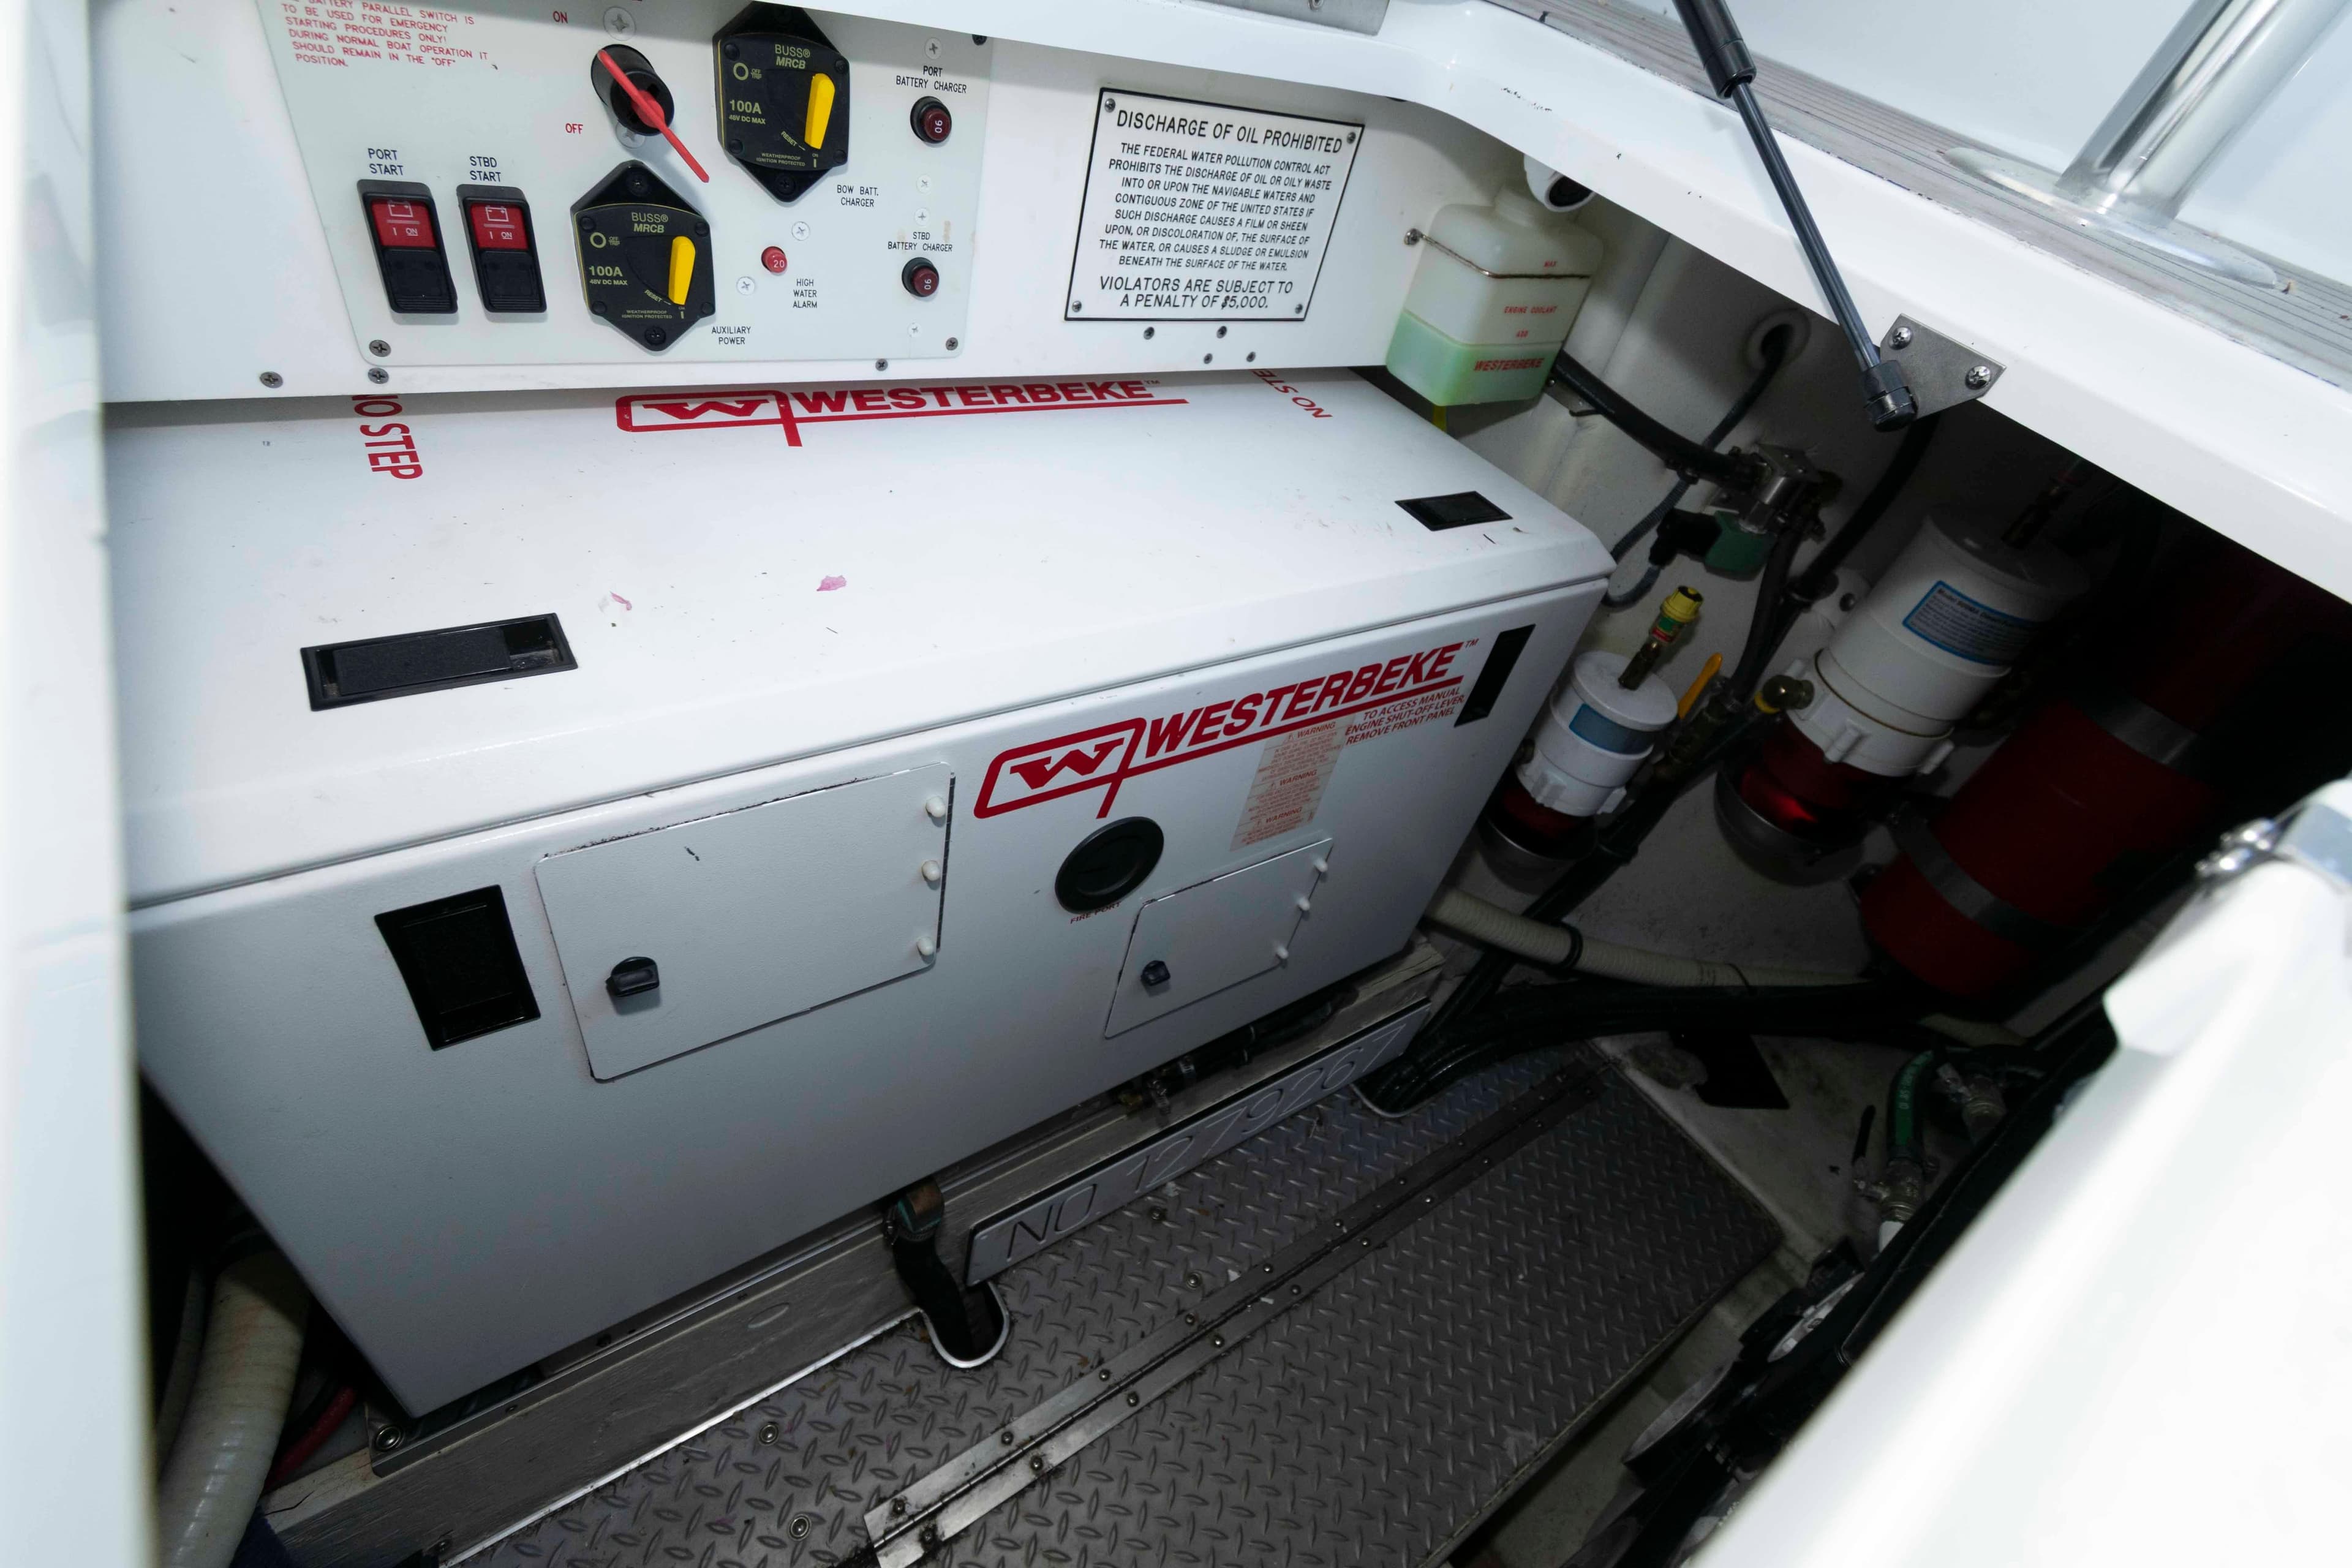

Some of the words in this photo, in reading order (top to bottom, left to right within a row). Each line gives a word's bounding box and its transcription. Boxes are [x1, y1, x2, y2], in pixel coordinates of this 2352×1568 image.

[282, 3, 297, 13] TO
[304, 7, 318, 17] BE
[326, 9, 354, 21] USED
[362, 13, 382, 24] FOR
[390, 18, 448, 32] EMERGENCY
[363, 2, 412, 17] PARALLEL
[420, 10, 458, 23] SWITCH
[465, 16, 475, 24] IS
[552, 10, 568, 23] ON
[285, 17, 336, 31] STARTING
[344, 23, 412, 40] PROCEDURES
[418, 33, 447, 43] ONLY!
[288, 29, 329, 41] DURING
[336, 34, 379, 47] NORMAL
[386, 40, 411, 51] BOAT
[419, 45, 472, 58] OPERATION
[292, 42, 334, 54] SHOULD
[342, 47, 382, 59] REMAIN
[388, 52, 399, 61] IN
[406, 54, 425, 64] THE
[295, 53, 349, 67] POSITION.
[776, 56, 806, 69] MRCB
[923, 65, 943, 77] PORT
[896, 75, 929, 89] BATTERY
[934, 81, 967, 93] CHARGER
[729, 99, 762, 114] 100A
[565, 123, 583, 134] OFF
[1117, 110, 1208, 137] DISCHARGE
[1213, 123, 1234, 140] OF
[1237, 126, 1258, 143] OIL
[1263, 129, 1343, 153] PROHIBITED
[780, 130, 797, 147] RESET
[368, 148, 398, 160] PORT
[470, 156, 497, 167] STBD
[1121, 142, 1141, 155] THE
[1144, 145, 1188, 160] FEDERAL
[1191, 151, 1223, 164] WATER
[1225, 154, 1272, 169] POLLUTION
[1274, 160, 1311, 173] CONTROL
[1314, 165, 1330, 175] ACT
[369, 164, 404, 175] START
[470, 170, 501, 182] START
[1109, 159, 1161, 174] PROHIBITS
[1164, 165, 1183, 176] THE
[1186, 167, 1237, 181] DISCHARGE
[1240, 173, 1252, 183] OF
[1254, 174, 1267, 184] OIL
[1270, 176, 1282, 186] OR
[1284, 177, 1303, 187] OILY
[1305, 179, 1332, 190] WASTE
[837, 184, 854, 194] BOW
[860, 186, 879, 196] BATT.
[1122, 177, 1144, 188] INTO
[1147, 179, 1161, 190] OR
[1164, 181, 1189, 192] UPON
[1192, 184, 1210, 194] THE
[1212, 185, 1261, 198] NAVIGABLE
[1263, 190, 1297, 202] WATERS
[1298, 194, 1316, 203] AND
[841, 197, 875, 208] CHARGER
[1115, 193, 1177, 207] CONTIGUOUS
[1179, 198, 1204, 209] ZONE
[1207, 201, 1219, 210] OF
[1221, 202, 1240, 212] THE
[1240, 205, 1271, 214] UNITED
[1273, 206, 1304, 216] STATES
[1306, 208, 1314, 217] IF
[633, 223, 665, 233] MRCB
[1115, 209, 1142, 221] SUCH
[1144, 211, 1197, 224] DISCHARGE
[1200, 215, 1235, 226] CAUSES
[1237, 218, 1243, 227] A
[1245, 218, 1265, 228] FILM
[1267, 220, 1279, 229] OR
[1280, 221, 1308, 231] SHEEN
[405, 227, 418, 236] ON
[913, 232, 930, 240] STBD
[1105, 224, 1133, 236] UPON,
[1136, 226, 1150, 236] OR
[1152, 227, 1223, 240] DISCOLORATION
[1242, 233, 1257, 243] THE
[1259, 234, 1296, 244] SURFACE
[1298, 236, 1310, 245] OF
[888, 241, 918, 251] BATTERY
[922, 243, 952, 252] CHARGER
[1099, 239, 1118, 250] THE
[1122, 240, 1155, 252] WATER,
[1158, 243, 1171, 252] OR
[1174, 244, 1209, 254] CAUSES
[1211, 246, 1217, 254] A
[1220, 246, 1253, 256] SLUDGE
[1255, 247, 1267, 257] OR
[1268, 248, 1309, 258] EMULSION
[589, 265, 623, 277] 100A
[774, 260, 785, 268] 20
[1118, 255, 1163, 266] BENEATH
[1166, 257, 1183, 268] THE
[1185, 258, 1225, 269] SURFACE
[1227, 260, 1239, 270] OF
[1242, 261, 1257, 270] THE
[1259, 262, 1287, 271] WATER.
[1100, 276, 1180, 292] VIOLATORS
[1184, 279, 1212, 292] ARE
[1215, 279, 1275, 293] SUBJECT
[1278, 281, 1294, 293] TO
[644, 289, 663, 303] RESET
[1120, 293, 1129, 307] A
[1134, 294, 1198, 307] PENALTY
[1202, 295, 1219, 307] OF
[1221, 295, 1268, 309] $5,000.
[1474, 357, 1545, 372] WESTERBEKE
[793, 380, 1154, 415] WESTERBEKE
[1292, 397, 1333, 418] NO
[360, 423, 423, 479] STEP
[1145, 641, 1464, 759] WESTERBEKE
[1363, 709, 1378, 721] TO
[1379, 699, 1418, 717] ACCESS
[1419, 687, 1460, 706] MANUAL
[1344, 717, 1387, 736] ENGINE
[1385, 704, 1436, 725] SHUT-OFF
[1346, 724, 1390, 745] REMOVE
[1391, 715, 1427, 732] FRONT
[1426, 706, 1455, 722] PANEL
[1297, 721, 1336, 738] WARNING
[1280, 769, 1317, 786] WARNING
[1265, 807, 1302, 823] WARNING
[1070, 912, 1091, 924] FIRE
[1006, 1183, 1097, 1262] NO
[1125, 1023, 1406, 1194] 1279267
